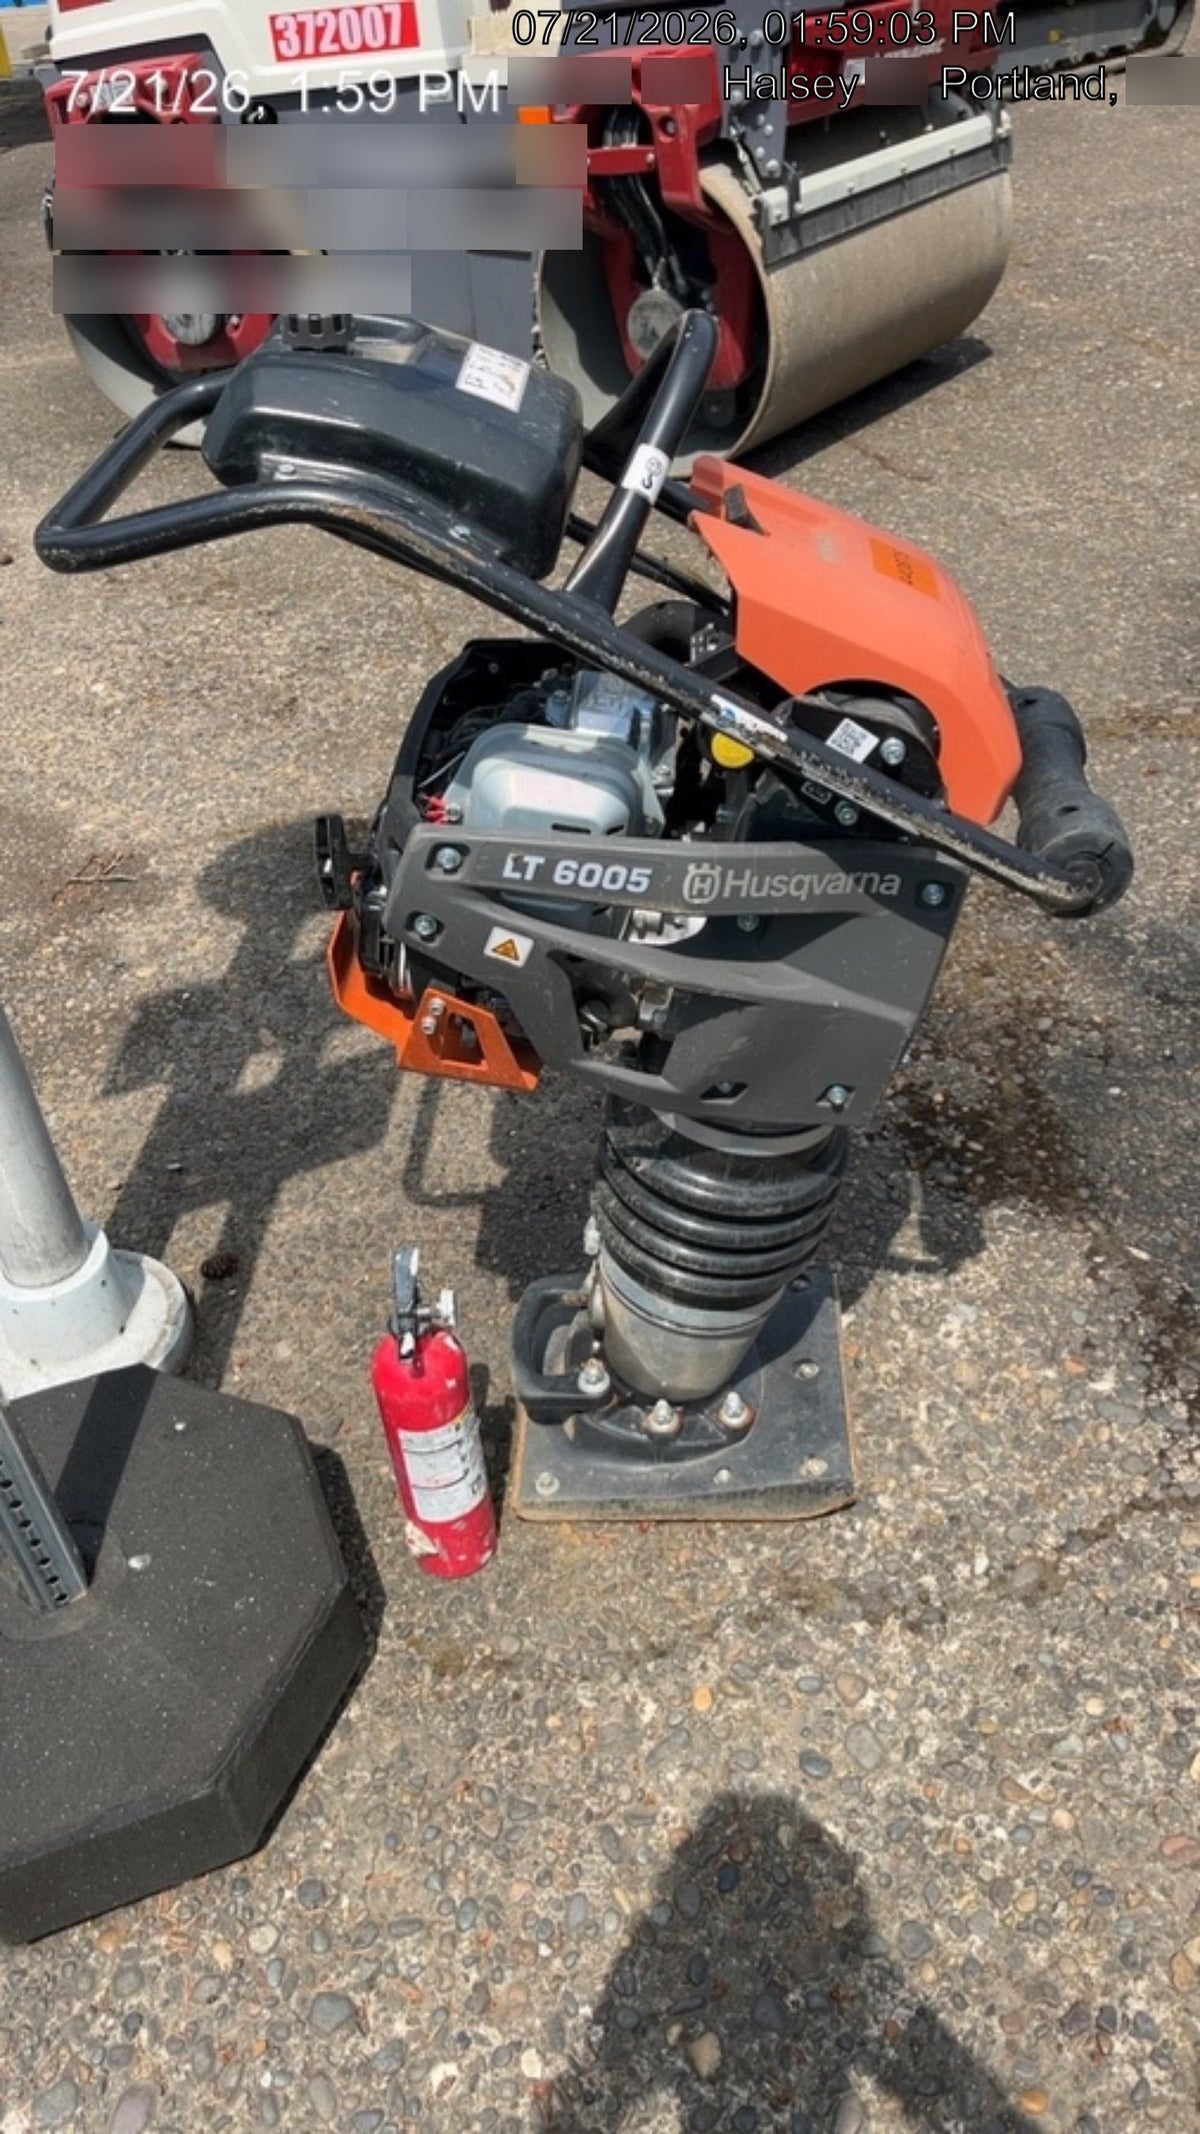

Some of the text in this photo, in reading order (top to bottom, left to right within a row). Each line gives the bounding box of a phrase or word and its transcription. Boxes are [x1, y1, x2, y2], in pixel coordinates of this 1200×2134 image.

[274, 4, 402, 58] 372007
[502, 852, 653, 893] LT 6005
[722, 869, 902, 902] Husqvarna
